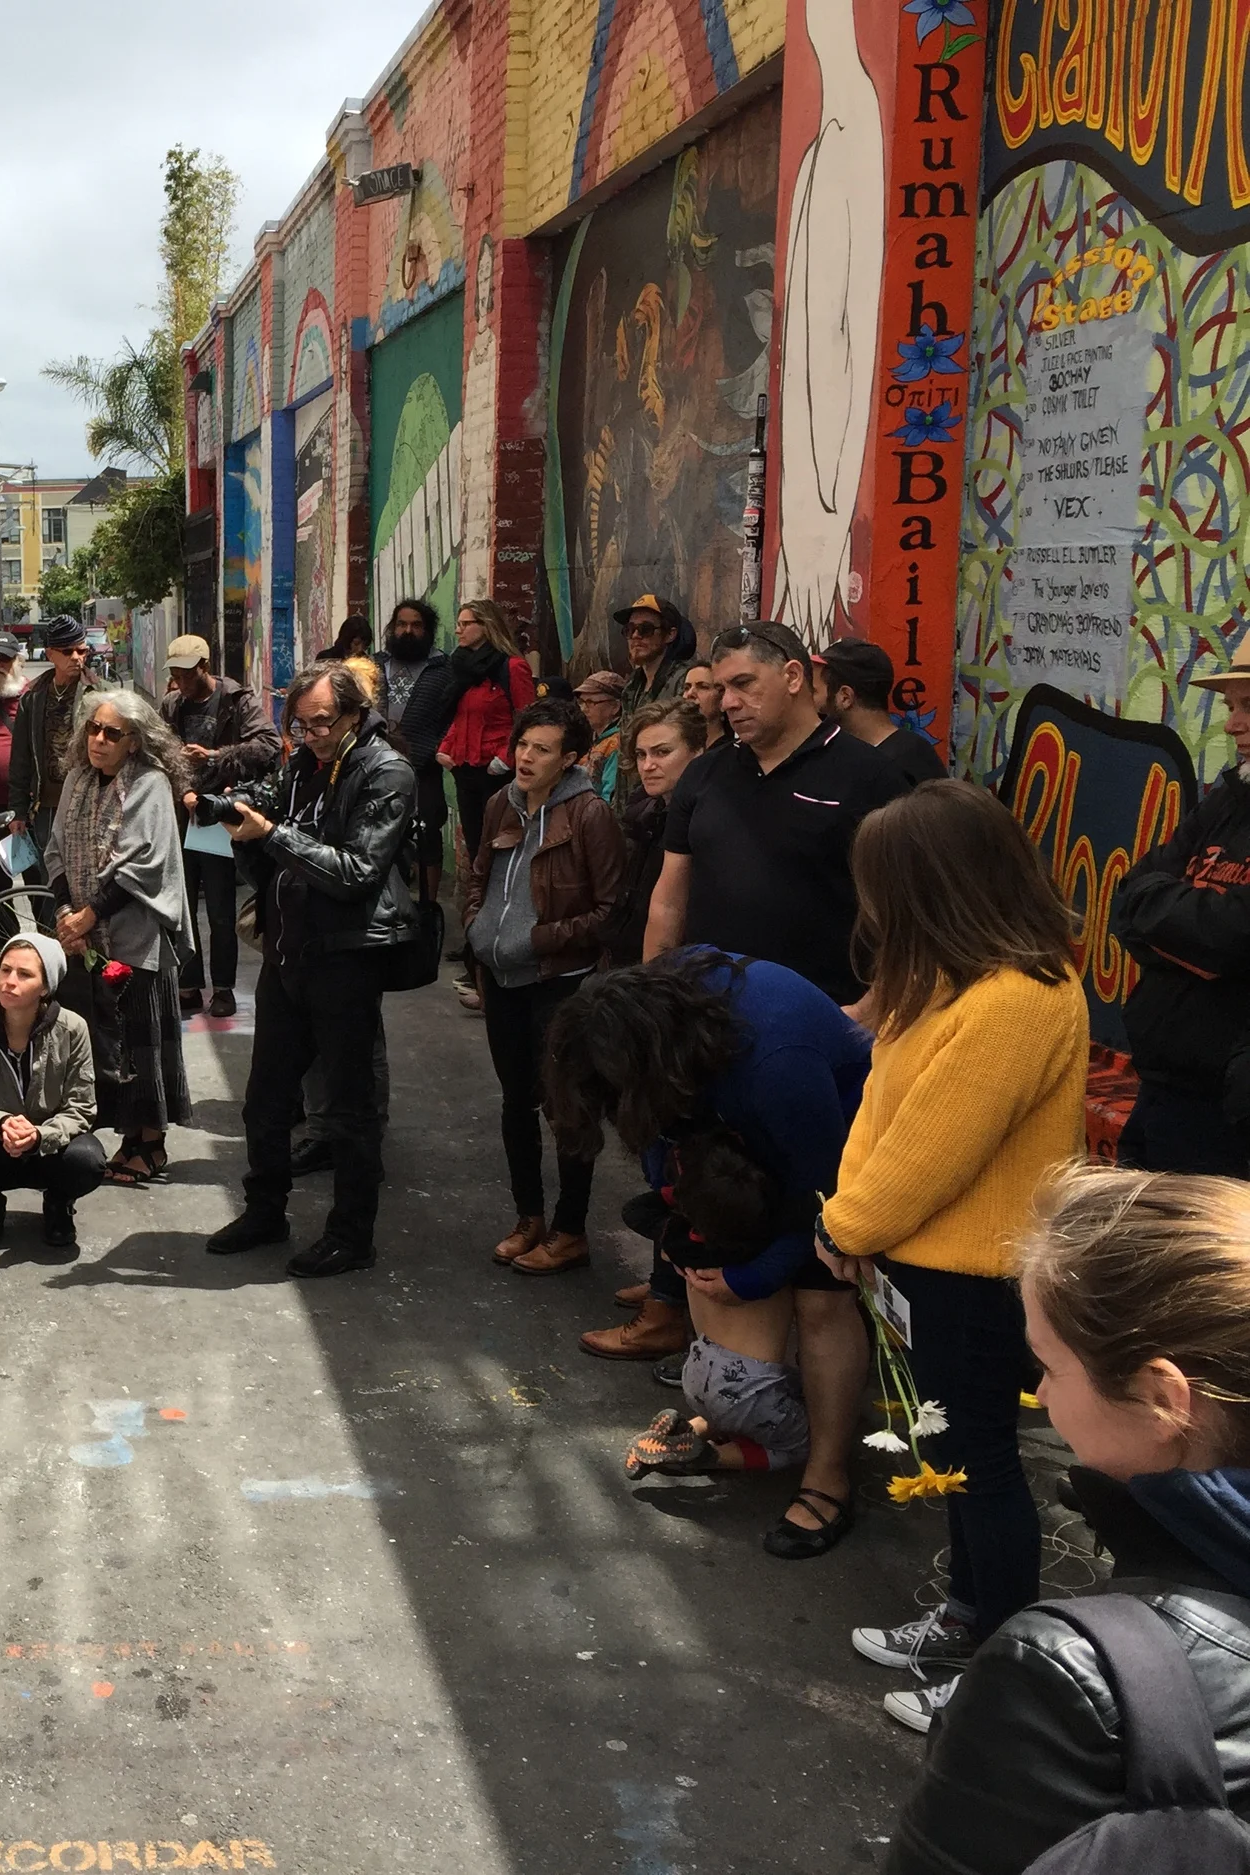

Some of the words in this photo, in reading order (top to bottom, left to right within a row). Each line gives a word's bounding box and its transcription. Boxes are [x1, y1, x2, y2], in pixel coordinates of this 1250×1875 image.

[899, 62, 970, 336] Rumah
[1041, 290, 1133, 331] stage
[1045, 329, 1076, 351] SILVER
[1067, 350, 1083, 366] FACE
[1054, 496, 1091, 519] VEX
[891, 450, 948, 712] Baile
[1080, 576, 1110, 600] Lovers
